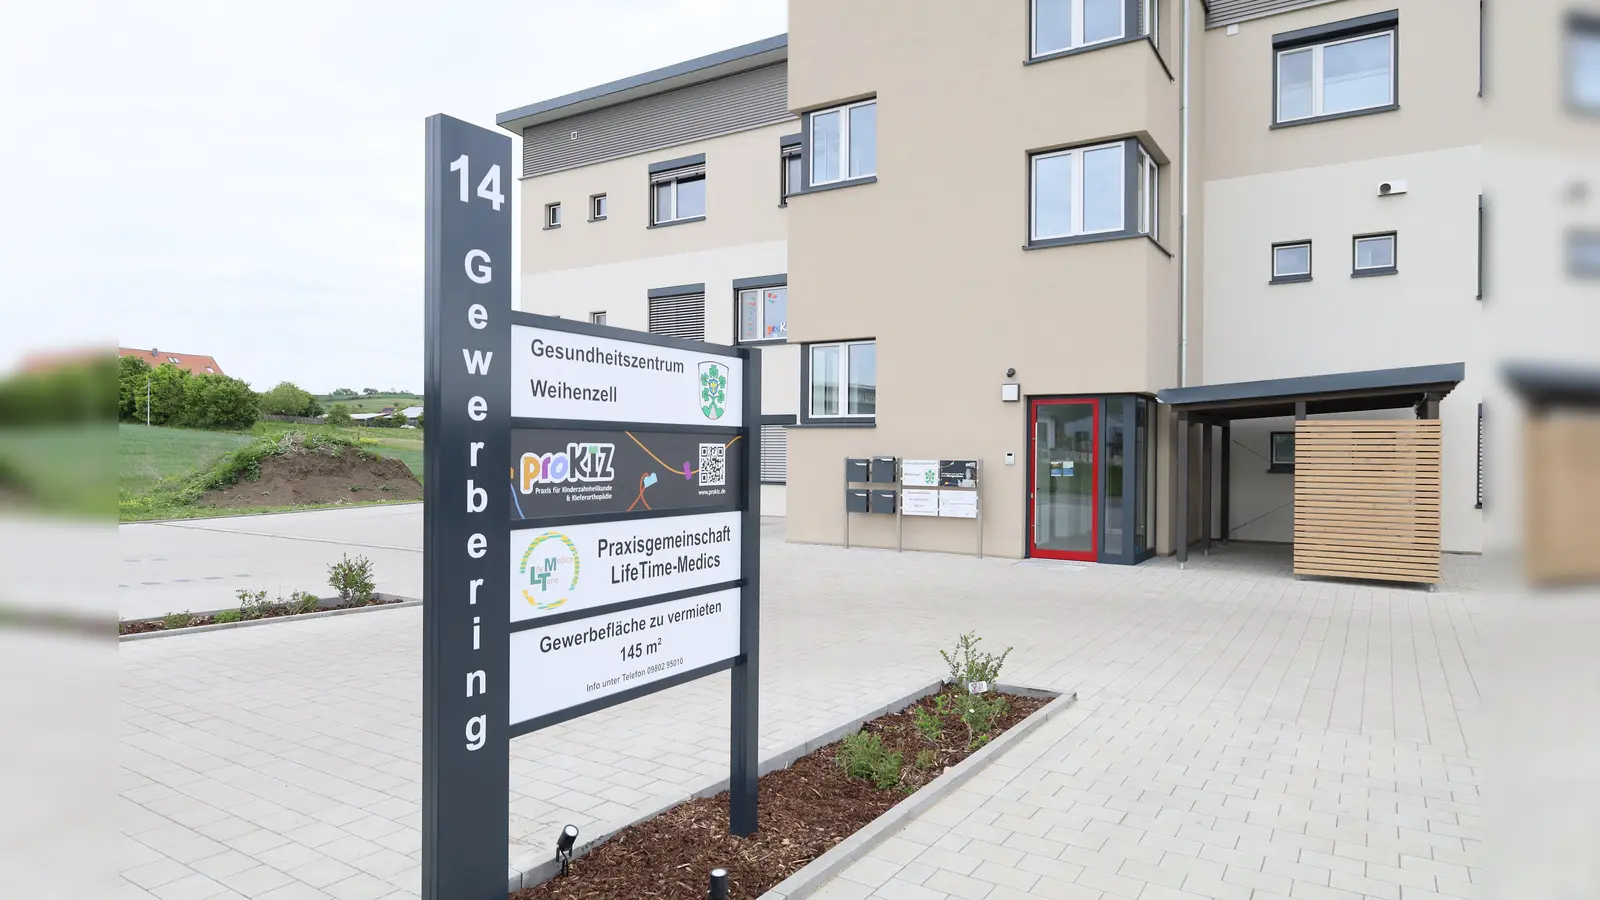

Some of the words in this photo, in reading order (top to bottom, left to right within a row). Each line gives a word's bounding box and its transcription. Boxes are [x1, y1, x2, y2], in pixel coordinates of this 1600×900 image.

[450, 154, 505, 212] 14
[530, 338, 685, 374] Gesundheitszentrum
[530, 378, 617, 403] Weihenzell
[462, 249, 494, 751] Gewerbering
[535, 487, 552, 495] Praxis
[552, 486, 561, 494] für
[561, 484, 613, 493] Kinderzahnheilkunde
[571, 493, 613, 502] Kieferorthopädie
[698, 488, 726, 496] www.prokiz.de
[597, 525, 731, 558] Praxisgemeinschaft
[610, 552, 721, 585] LifeTime-Medics
[539, 618, 646, 653] Gewerbefläche
[649, 614, 664, 629] zu
[667, 602, 722, 625] vermieten
[620, 642, 643, 662] 145
[586, 682, 601, 692] Info
[602, 676, 621, 688] unter
[621, 669, 646, 682] Telefon
[646, 662, 666, 675] 09802
[665, 657, 684, 669] 95010
